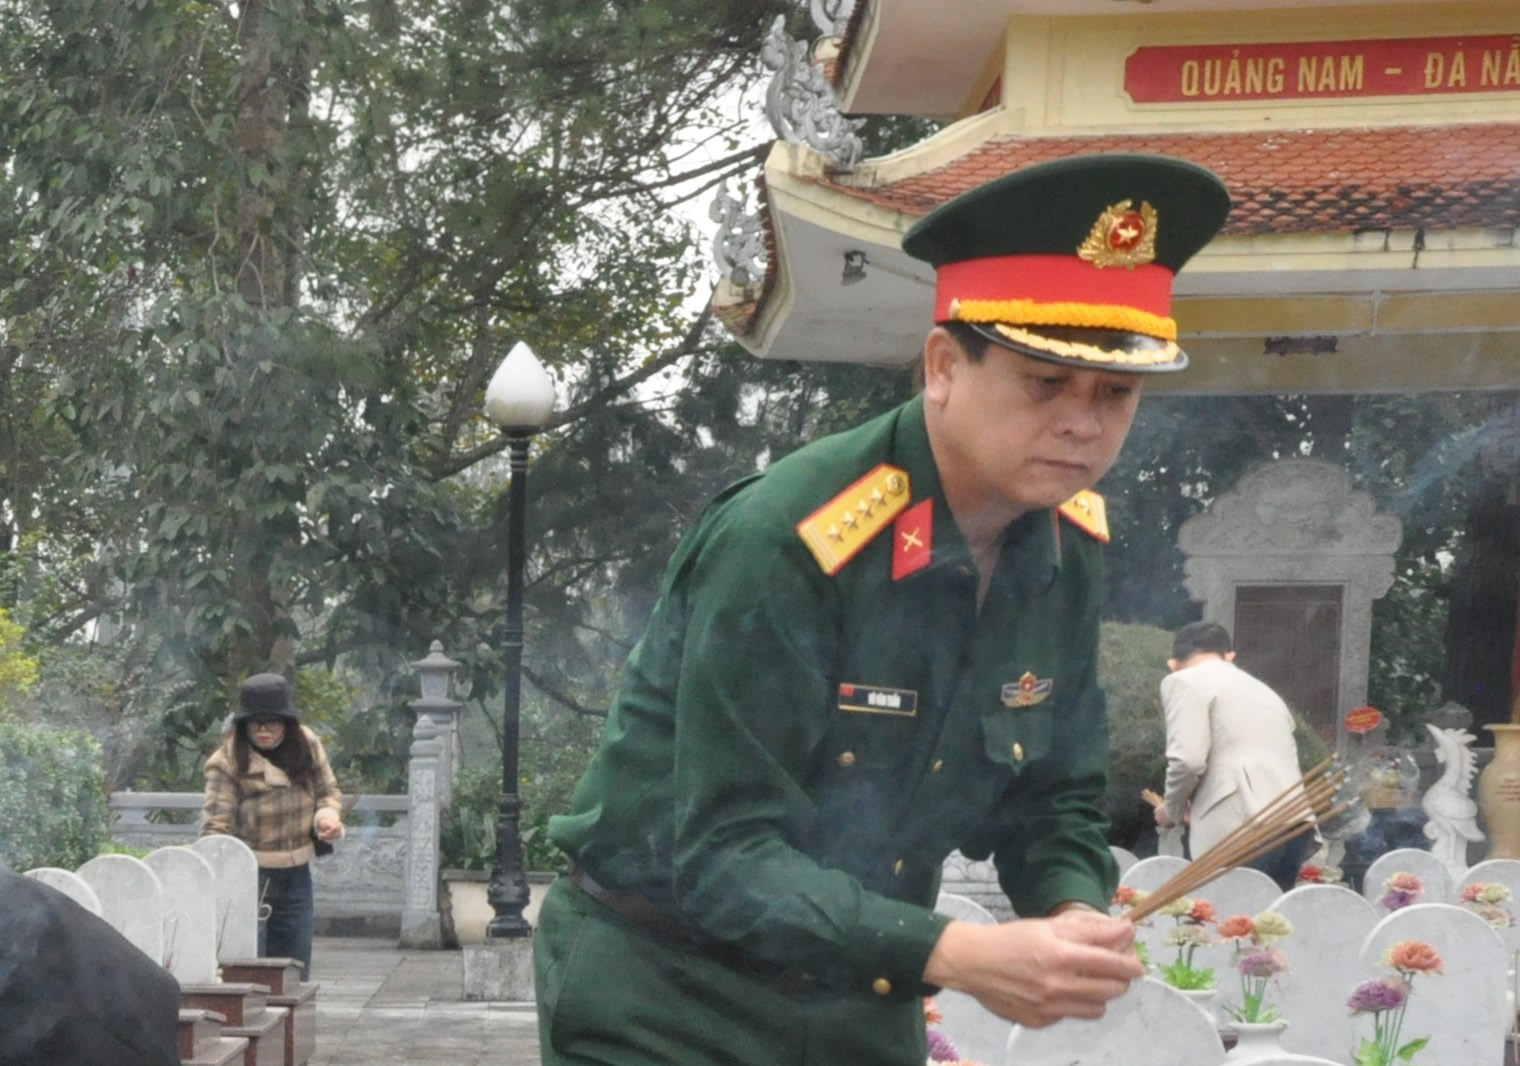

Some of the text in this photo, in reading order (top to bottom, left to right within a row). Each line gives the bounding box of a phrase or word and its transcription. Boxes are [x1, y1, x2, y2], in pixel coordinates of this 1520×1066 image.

[1180, 49, 1285, 96] QUẢNG
[1297, 54, 1365, 92] NAM
[1423, 41, 1467, 89] ĐÀ
